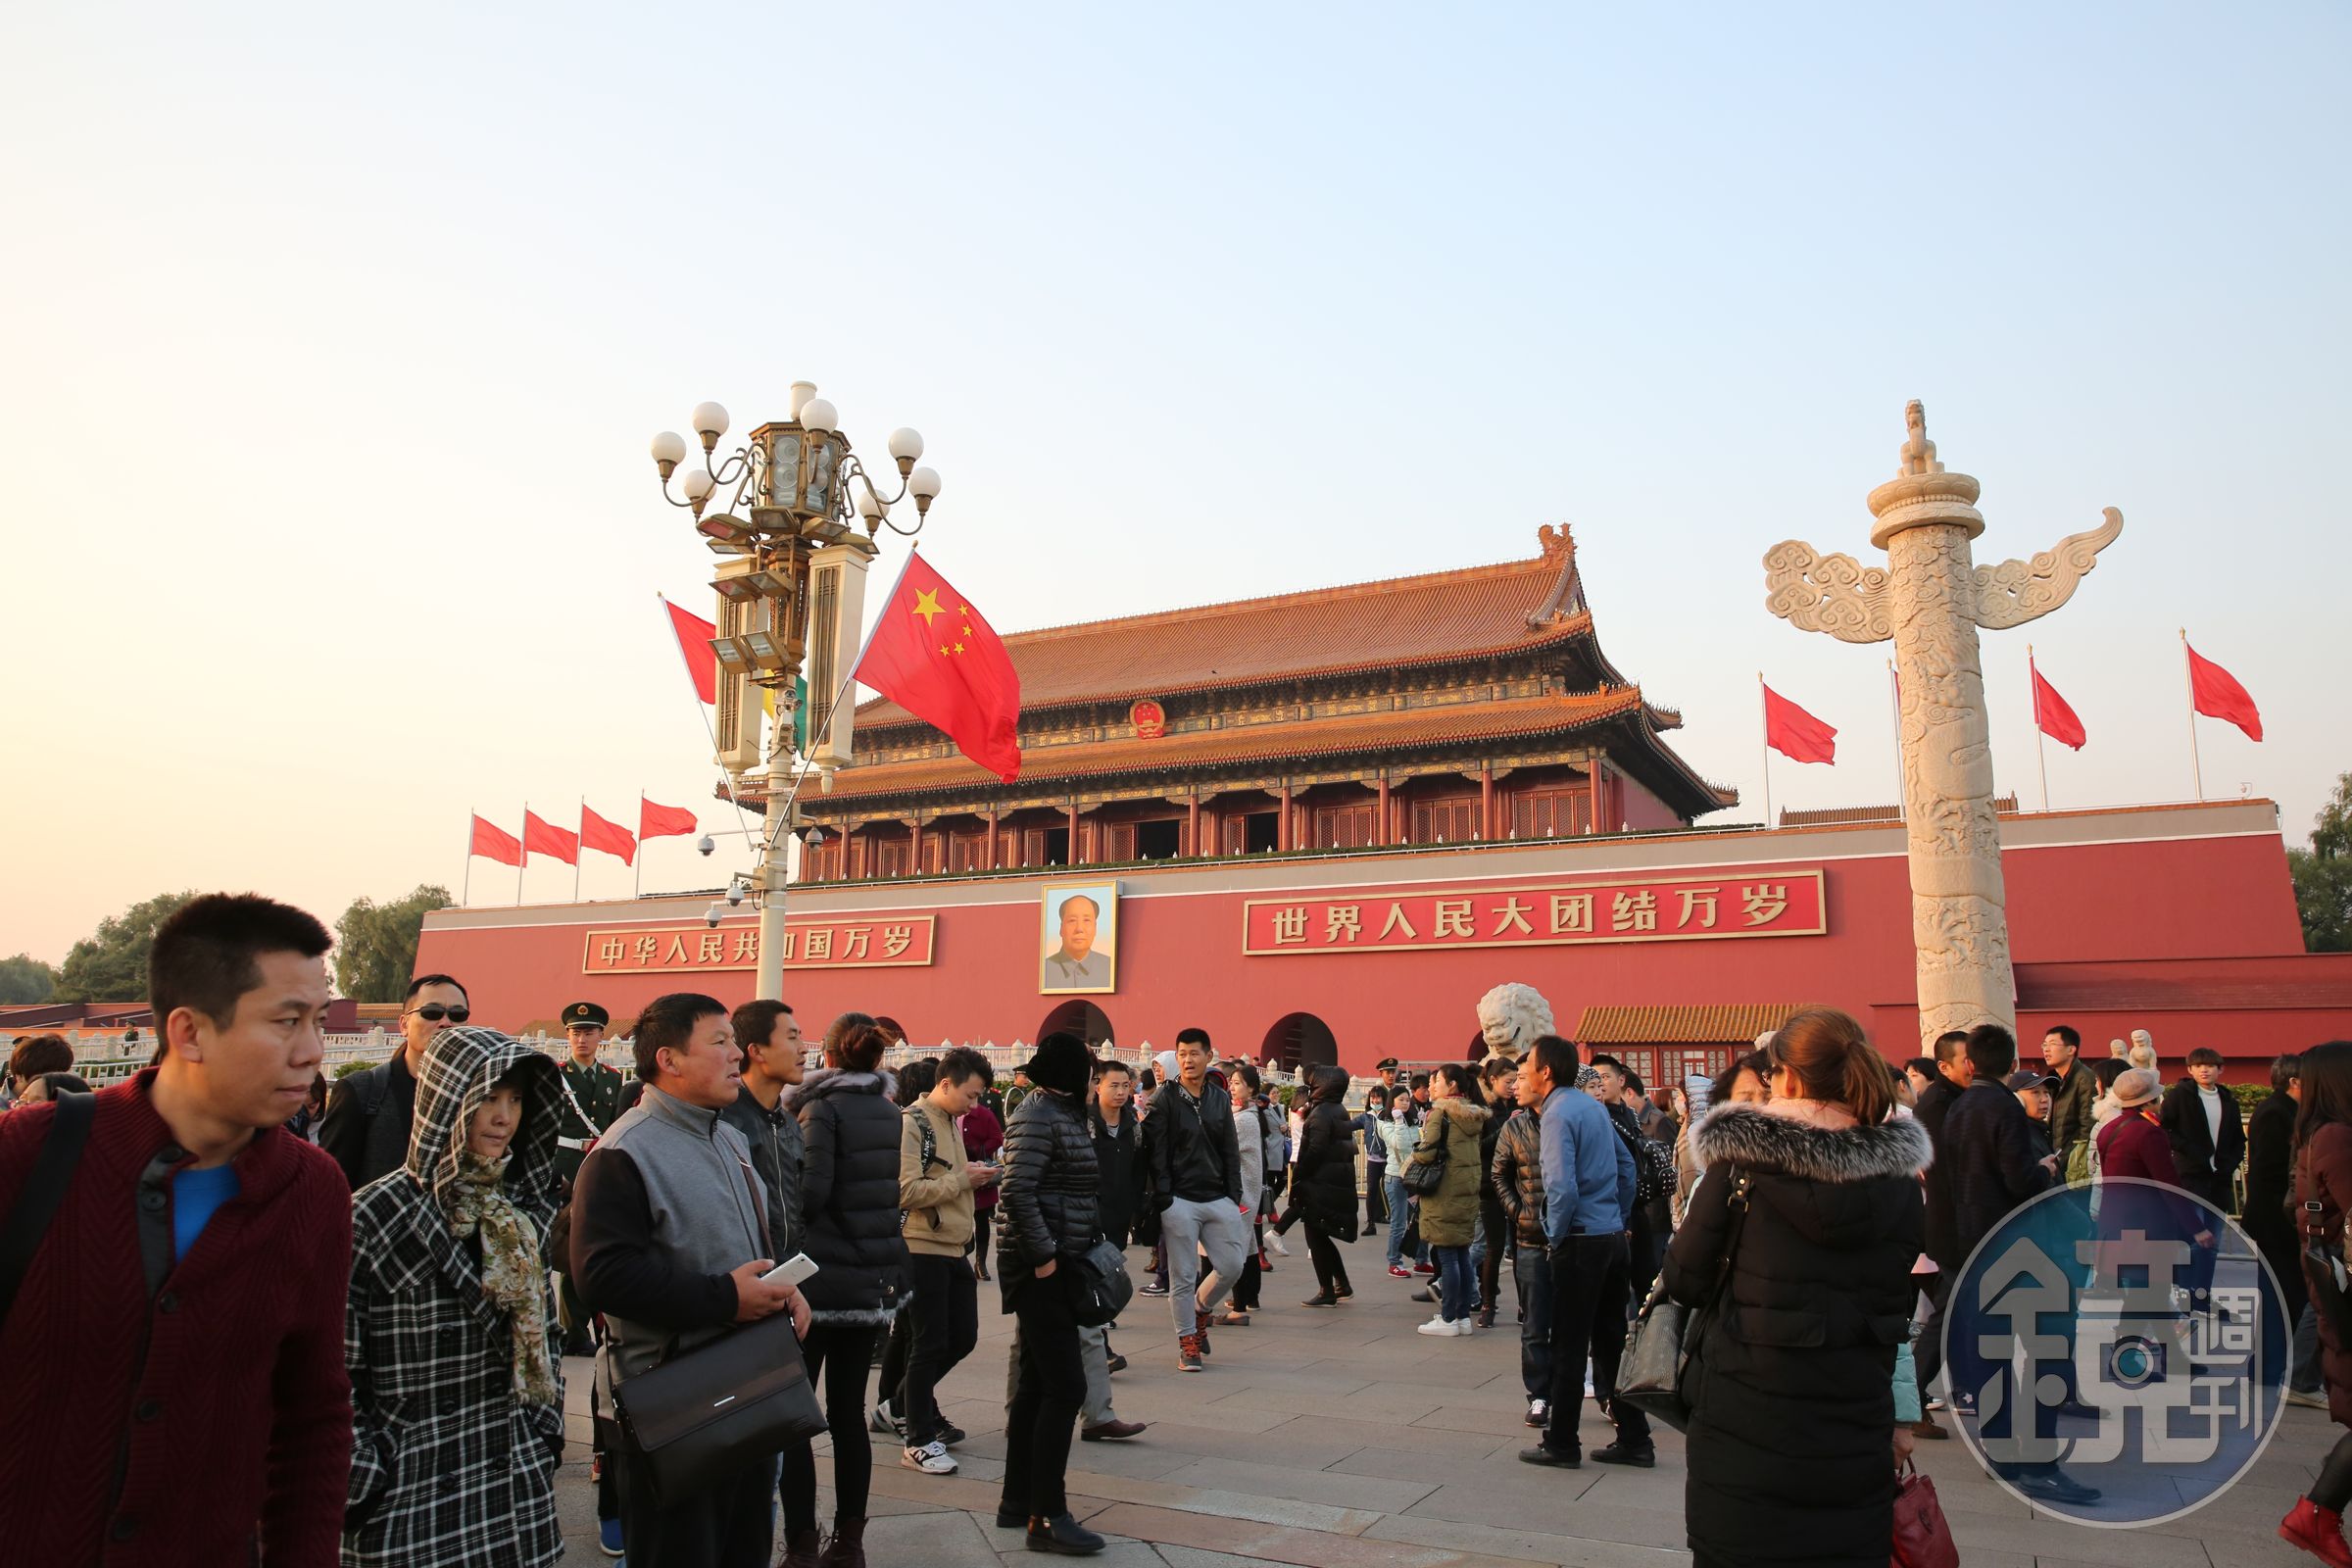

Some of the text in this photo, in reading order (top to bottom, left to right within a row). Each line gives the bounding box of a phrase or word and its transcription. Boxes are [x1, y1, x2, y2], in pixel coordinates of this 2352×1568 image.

[1271, 883, 1790, 945] 世界人民大团结万岁
